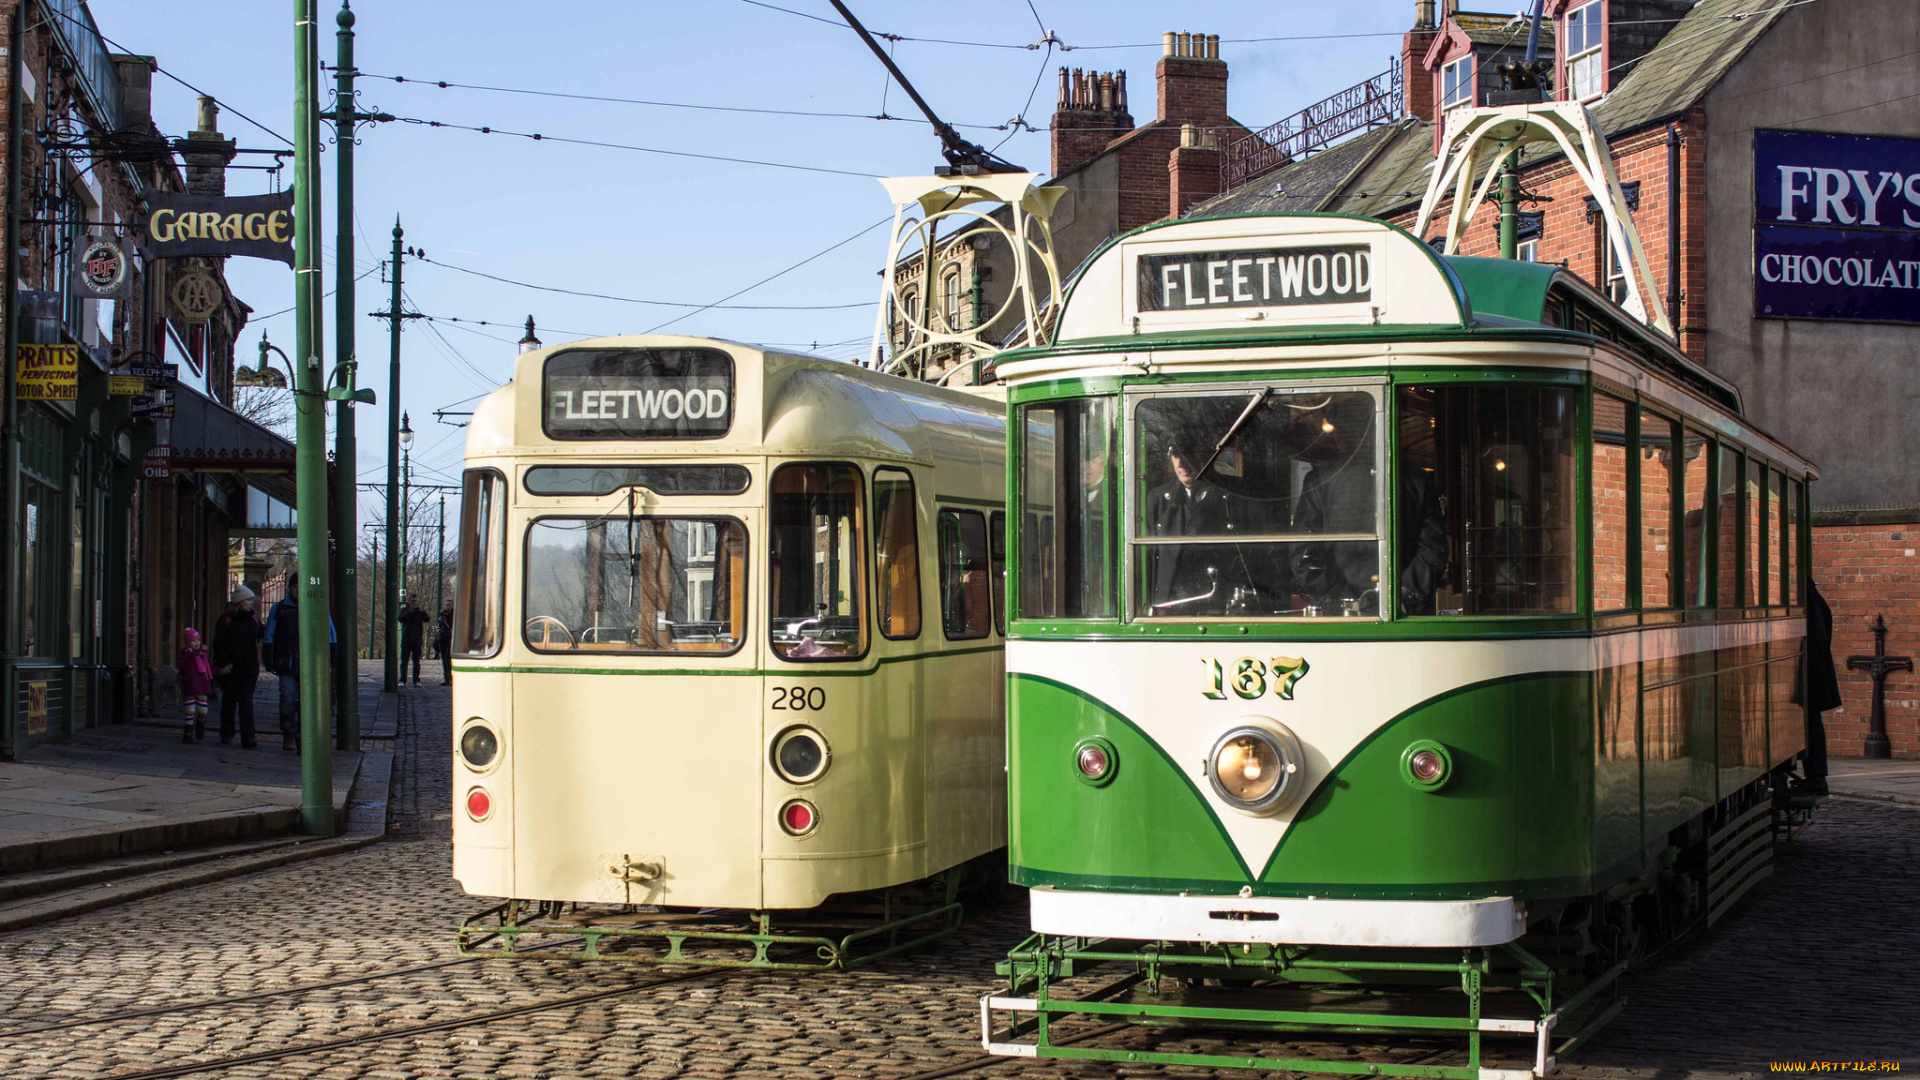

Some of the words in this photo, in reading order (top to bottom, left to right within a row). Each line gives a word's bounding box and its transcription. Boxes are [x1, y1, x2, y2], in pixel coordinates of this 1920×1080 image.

[1776, 165, 1920, 228] FRY'S
[150, 208, 289, 243] GARAGE
[88, 257, 117, 277] HF
[1161, 251, 1371, 307] FLEETWOOD
[1760, 253, 1920, 289] CHOCOLAT
[21, 370, 77, 380] PERFECTION
[46, 382, 77, 398] SPIRIT
[551, 388, 728, 420] FLEETWOOD
[145, 467, 169, 478] Oils
[1199, 656, 1310, 701] 167
[771, 686, 826, 711] 280
